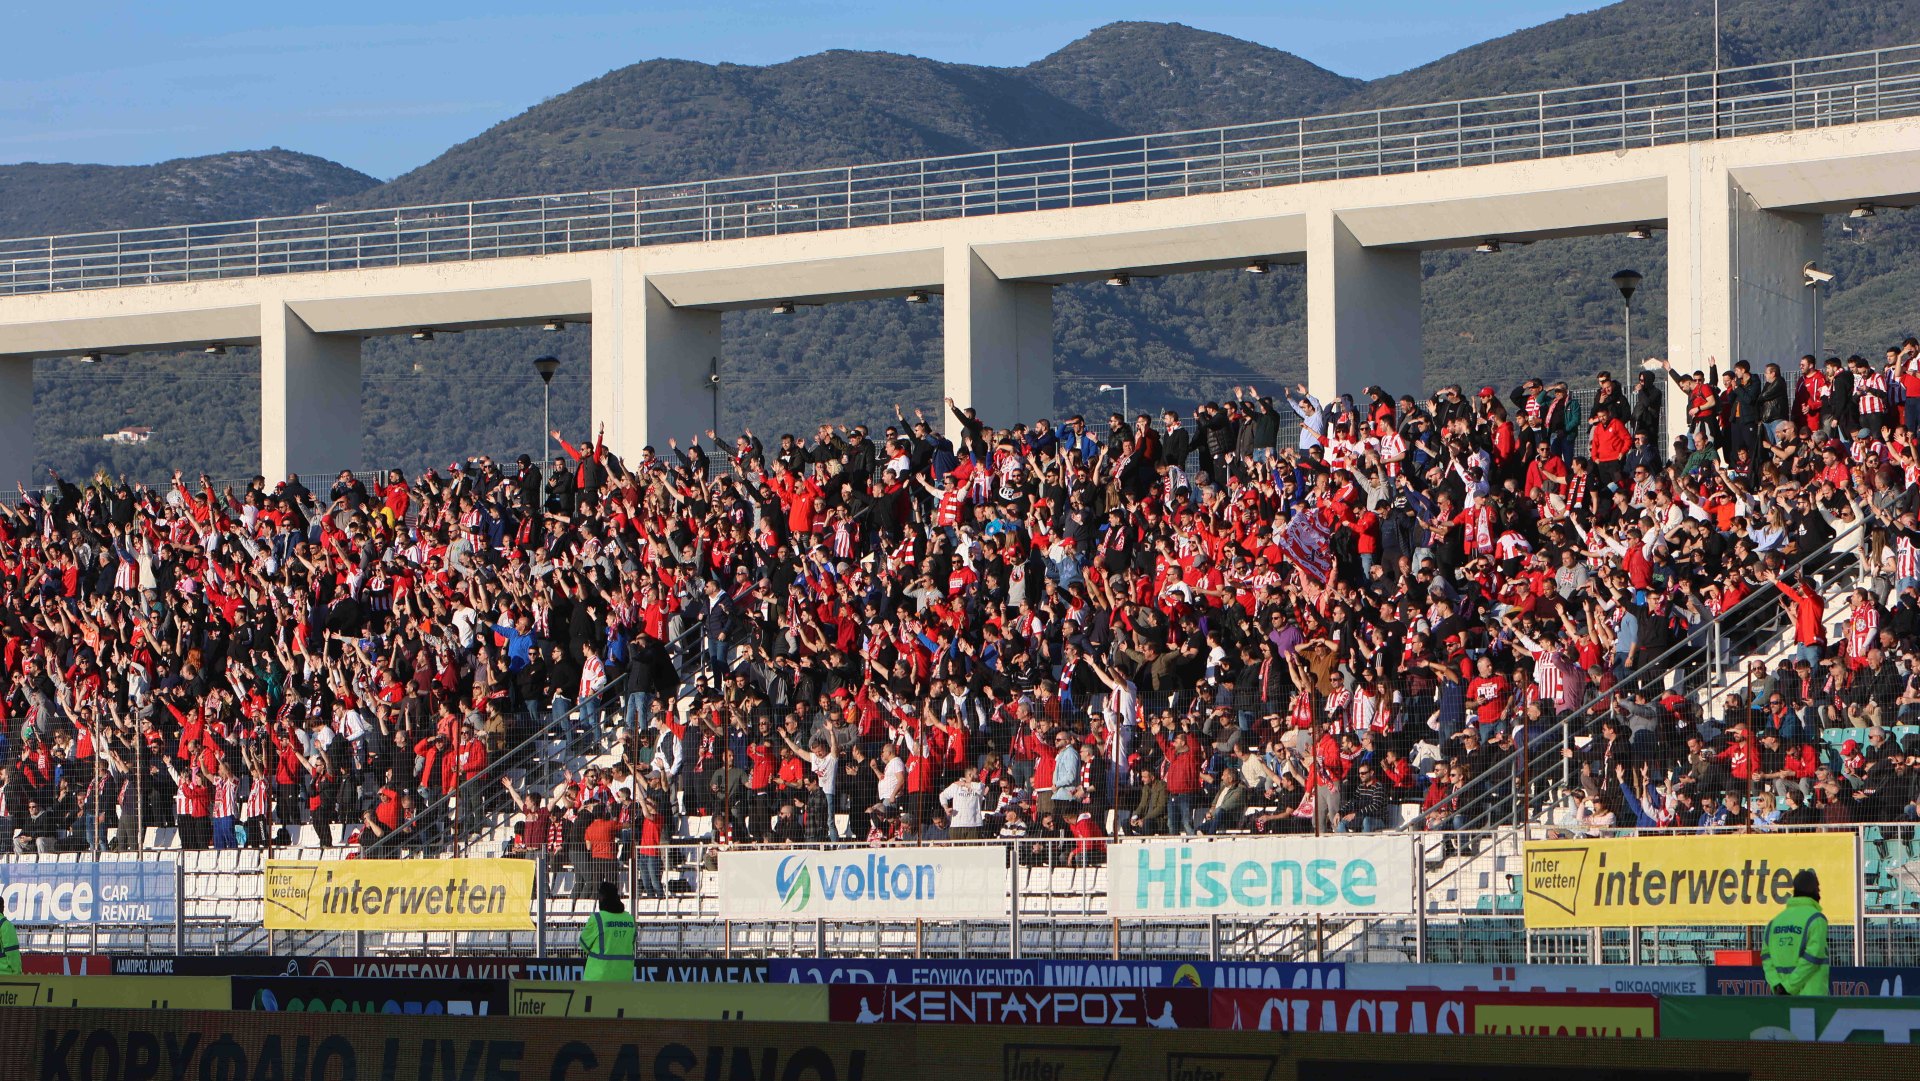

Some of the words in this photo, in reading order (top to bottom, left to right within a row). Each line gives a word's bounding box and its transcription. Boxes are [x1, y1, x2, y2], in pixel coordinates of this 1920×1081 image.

[1530, 851, 1560, 873] inter
[268, 869, 292, 885] inter
[817, 853, 936, 901] volton
[1136, 847, 1377, 909] Hisense
[1534, 874, 1576, 889] wetten
[1593, 852, 1816, 907] interwette
[0, 882, 94, 921] ance
[101, 885, 129, 902] CAR
[272, 886, 306, 899] wetten
[322, 870, 507, 915] interwetten
[101, 904, 153, 921] RENTAL
[116, 958, 148, 974] ΛΑΜΠΡΟΣ
[149, 959, 174, 974] ΛΙΑΡΟΣ
[518, 991, 546, 1015] inter
[891, 990, 1137, 1025] ΚΕΝΤΑΥΡΟΣ
